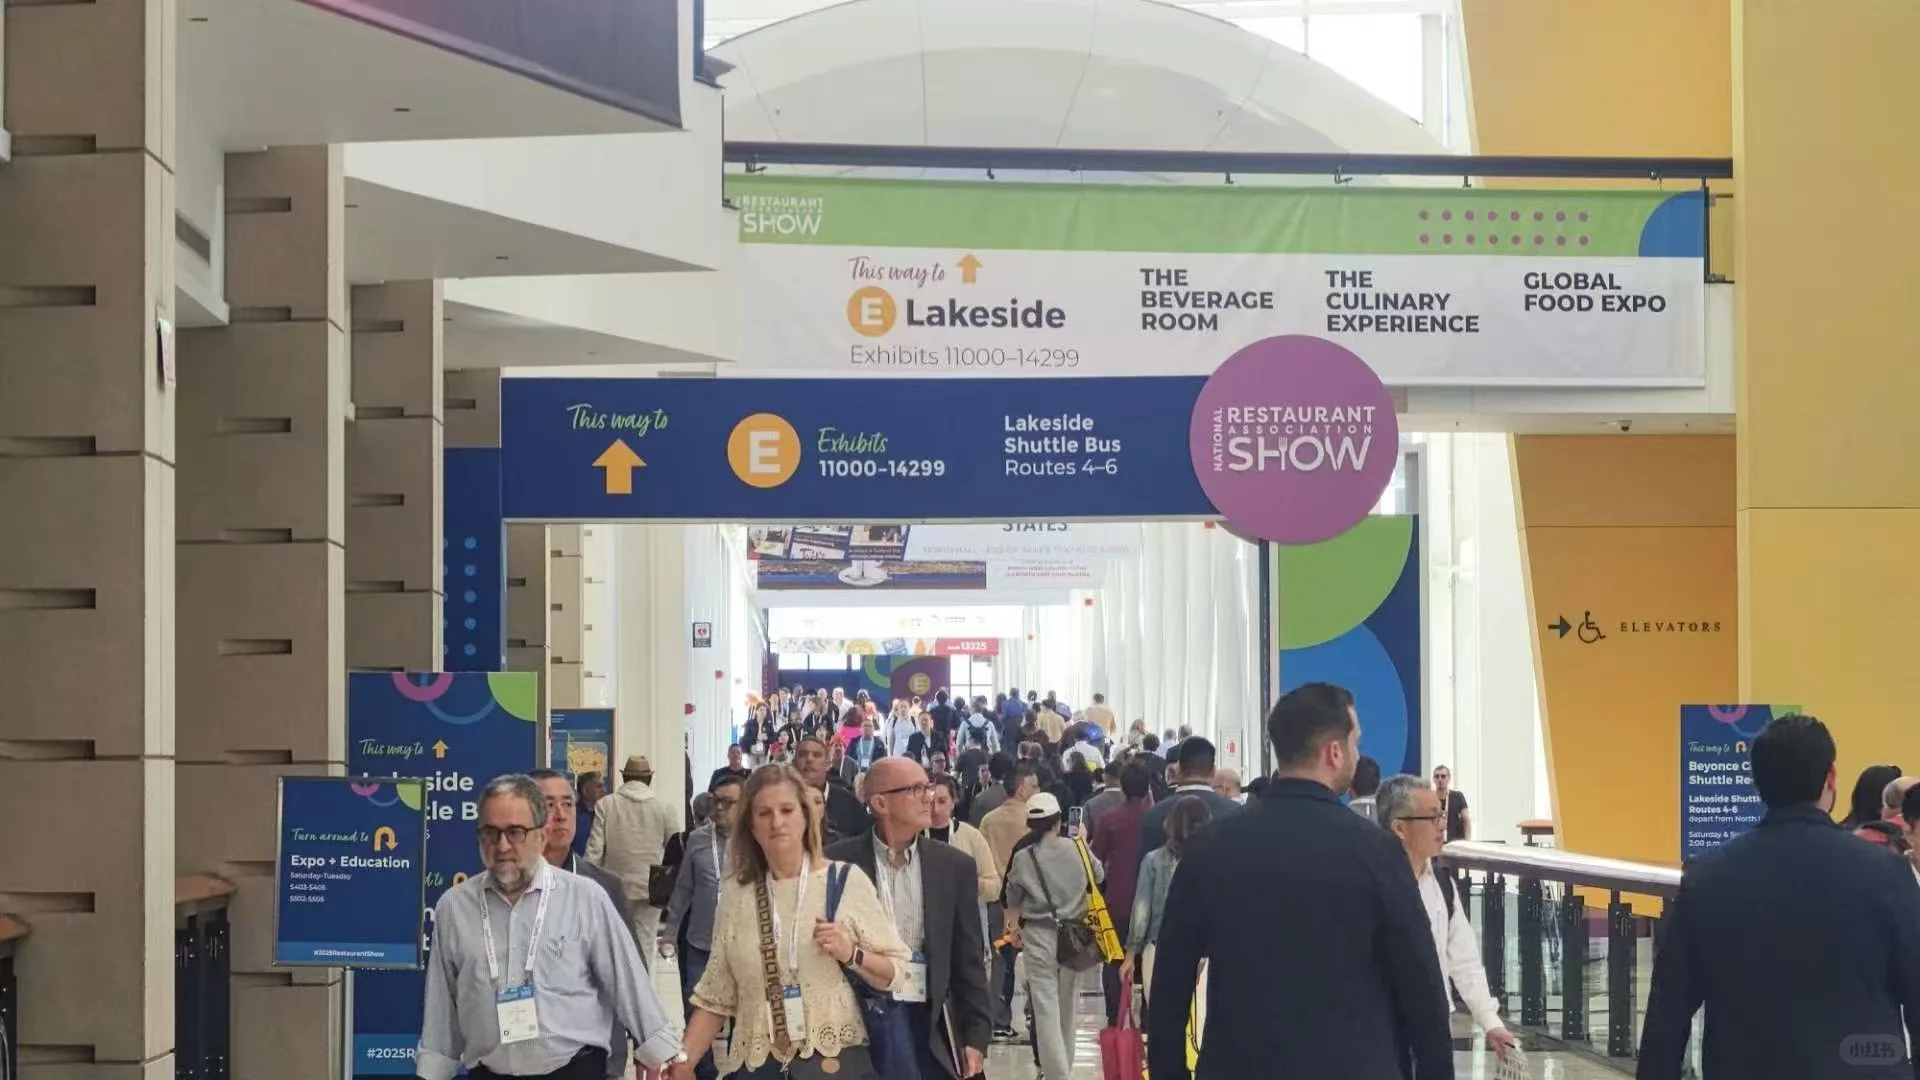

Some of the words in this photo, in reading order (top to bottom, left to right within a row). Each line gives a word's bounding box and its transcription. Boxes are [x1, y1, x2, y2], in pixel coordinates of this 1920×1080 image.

[743, 213, 823, 235] SHOW
[848, 255, 884, 280] This
[888, 264, 927, 289] way
[930, 262, 945, 281] to
[1140, 268, 1188, 286] THE
[1325, 270, 1373, 289] THE
[1523, 271, 1622, 291] GLOBAL
[1141, 290, 1274, 309] BEVERAGE
[1326, 291, 1451, 312] CULINARY
[1524, 294, 1593, 312] FOOD
[1602, 294, 1667, 313] EXPO
[860, 297, 884, 326] E
[906, 298, 1066, 329] Lakeside
[1141, 312, 1218, 331] ROOM
[1326, 314, 1480, 333] EXPERIENCE
[850, 344, 939, 366] Exhibits
[566, 403, 606, 430] This
[610, 412, 650, 437] way
[652, 408, 668, 430] to
[1004, 414, 1094, 432] Lakeside
[1227, 406, 1377, 424] RESTAURANT
[1227, 425, 1373, 434] ASSOCIATION
[817, 426, 889, 454] Exhibits
[1004, 436, 1079, 454] Shuttle
[1085, 436, 1121, 453] Bus
[1212, 408, 1223, 472] NATIONAL
[749, 431, 781, 474] E
[1228, 436, 1372, 471] SHOW
[1005, 458, 1076, 476] Routes
[1619, 621, 1722, 633] ELEVATORS
[360, 738, 384, 756] This
[387, 744, 412, 760] way
[412, 741, 424, 755] to
[1688, 761, 1739, 773] Beyonce
[1688, 775, 1733, 785] Shuttle
[1688, 794, 1729, 803] Lakeside
[1731, 795, 1761, 803] Shuttl
[1688, 805, 1722, 814] Routes
[1688, 815, 1714, 823] depart
[291, 827, 317, 841] Turn
[320, 830, 358, 842] around
[359, 831, 369, 842] to
[1688, 831, 1722, 839] Saturday
[291, 854, 326, 869] Expo
[328, 857, 337, 865] +
[340, 855, 410, 869] Education
